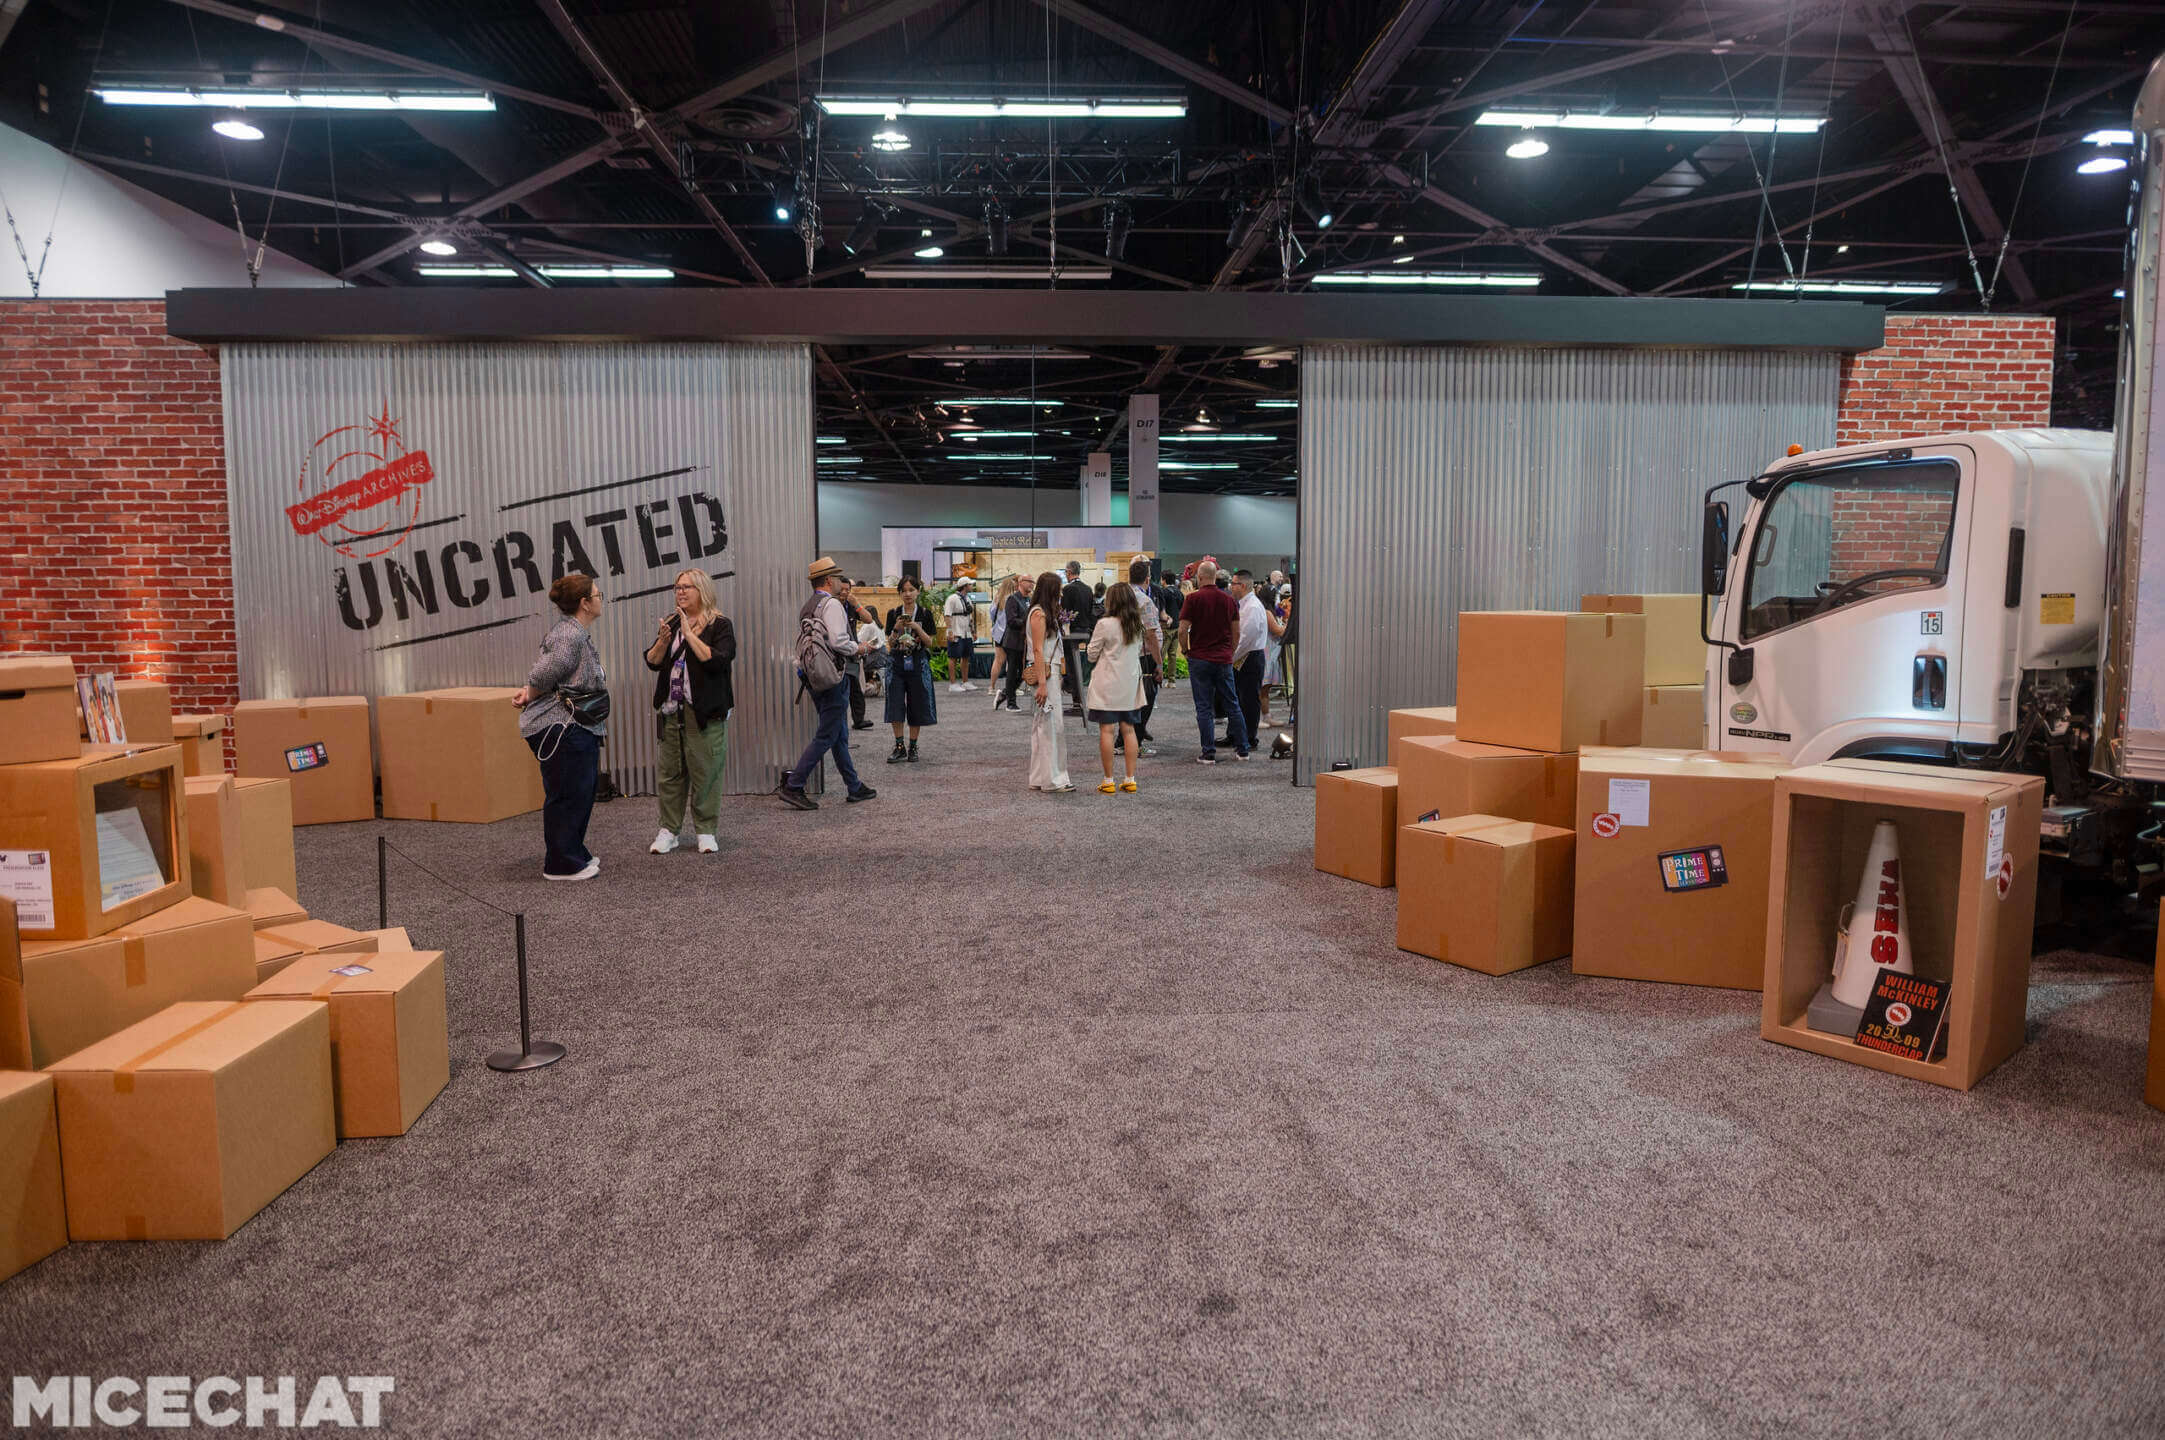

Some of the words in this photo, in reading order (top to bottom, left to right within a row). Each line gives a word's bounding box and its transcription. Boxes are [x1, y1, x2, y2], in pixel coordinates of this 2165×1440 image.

[1136, 420, 1154, 428] D17
[363, 461, 426, 498] ARCHIVES
[333, 492, 730, 631] UNCRATED
[1924, 618, 1940, 633] 15
[1663, 857, 1704, 872] PRIME
[1675, 869, 1706, 881] TIME
[1885, 975, 1938, 998] WILLIAM
[1856, 1033, 1923, 1060] THUNDERCLAP
